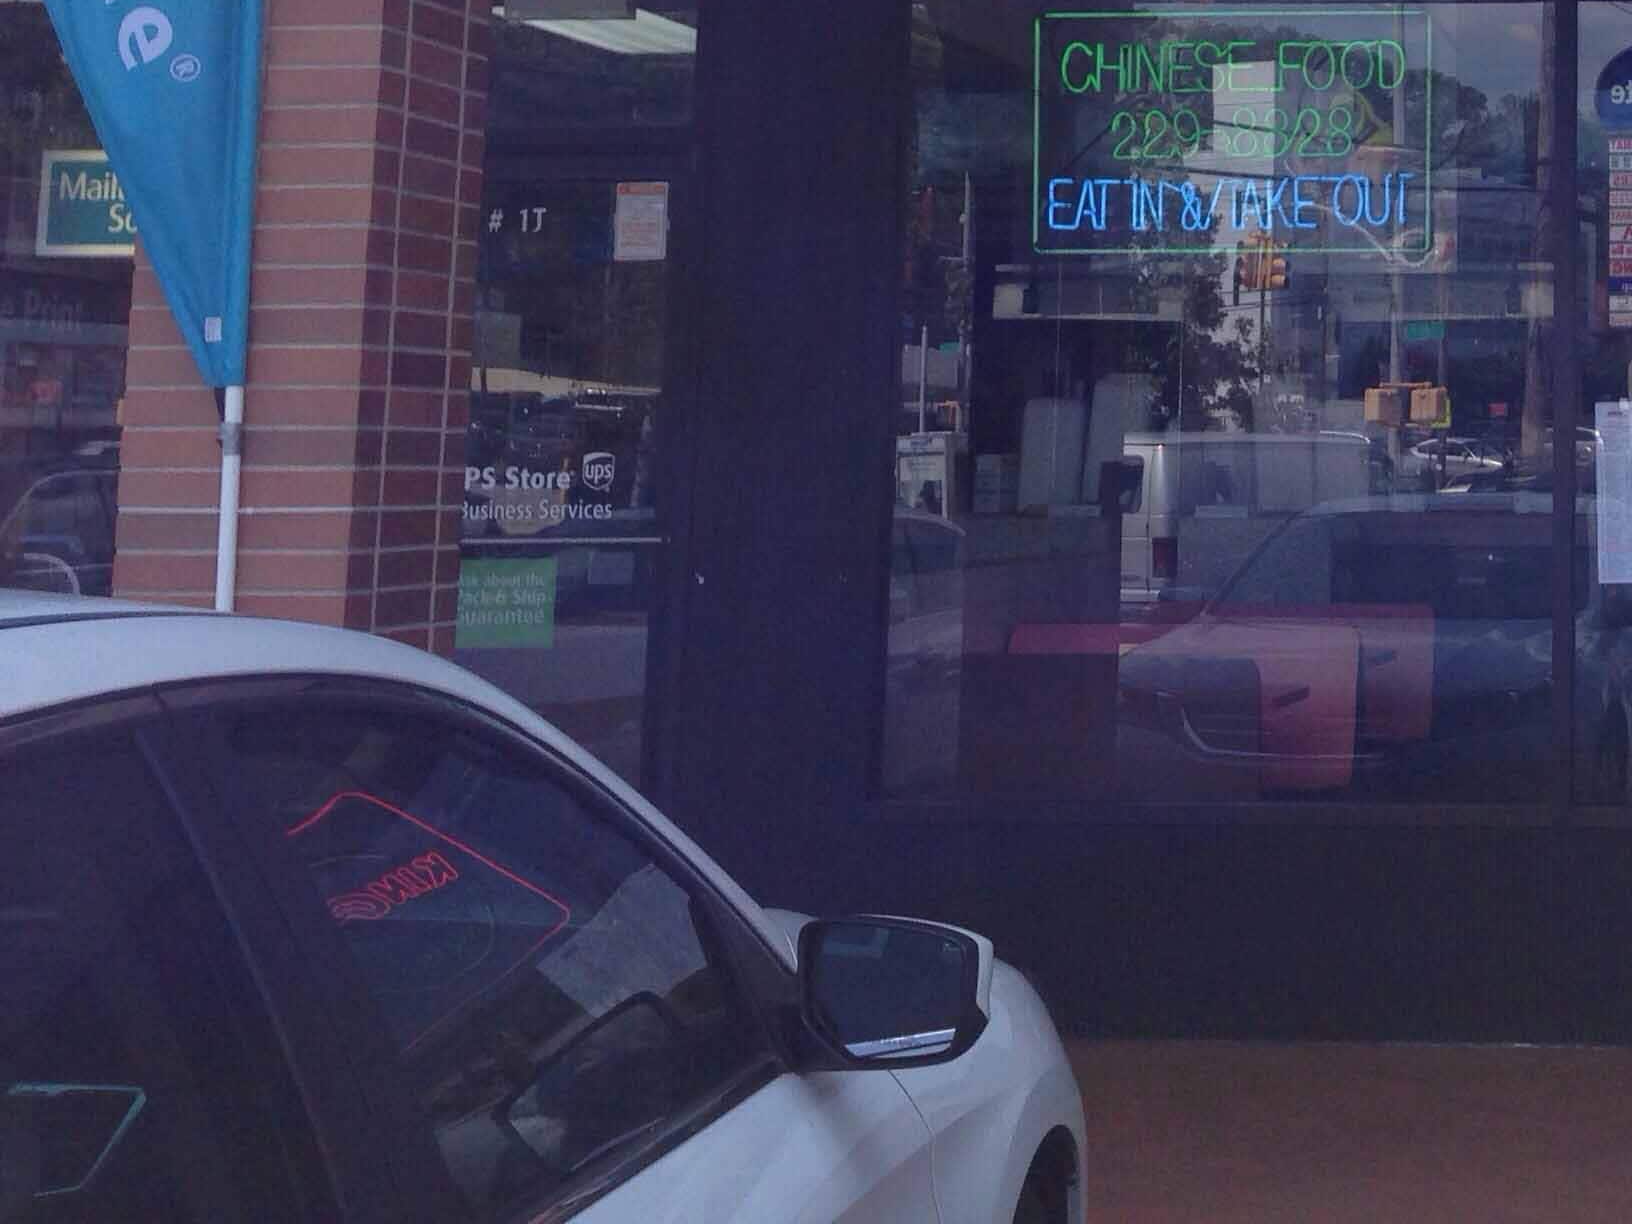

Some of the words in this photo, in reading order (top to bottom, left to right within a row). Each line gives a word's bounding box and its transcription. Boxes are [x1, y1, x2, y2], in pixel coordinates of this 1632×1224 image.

[1061, 39, 1258, 94] CHINESE
[1277, 39, 1407, 92] FOOD
[1047, 177, 1107, 231] EAT
[1131, 178, 1163, 231] IN
[1180, 176, 1203, 231] &
[1219, 176, 1317, 230] TAKE
[1333, 173, 1414, 228] OUT
[464, 465, 497, 491] PS
[504, 464, 571, 490] Store
[584, 462, 613, 485] ups
[538, 497, 614, 521] Services
